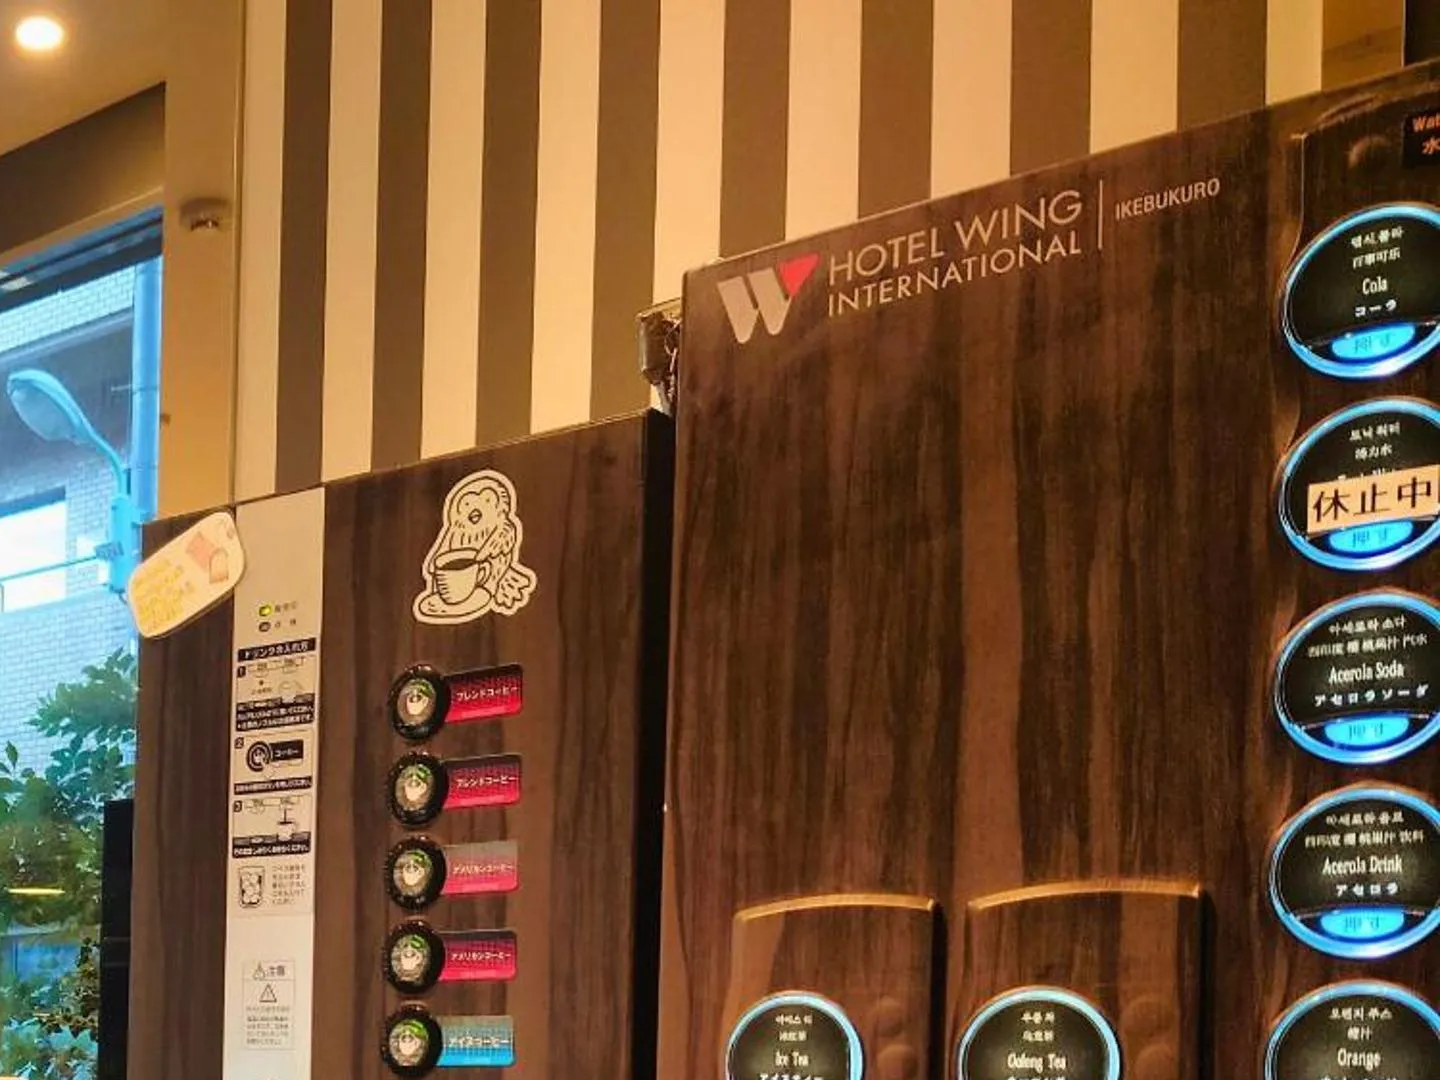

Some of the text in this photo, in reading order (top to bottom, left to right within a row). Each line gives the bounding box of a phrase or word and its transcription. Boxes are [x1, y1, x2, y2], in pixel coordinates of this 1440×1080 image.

[1116, 178, 1220, 220] IKEBUKURO
[829, 190, 1082, 285] HOTEL WING
[828, 230, 1081, 316] INTERNATIONAL
[1363, 276, 1388, 295] Cola
[1355, 299, 1397, 318] コーラ
[1313, 477, 1431, 522] 休止中
[1328, 659, 1404, 685] Acerola Soda
[456, 685, 519, 701] ブレンドコーヒー
[1322, 854, 1402, 875] Acerola Drink
[1336, 881, 1398, 897] アセロラ
[775, 1049, 810, 1066] Ice Tea
[1048, 1053, 1067, 1070] Tea
[1337, 1047, 1381, 1071] Orange
